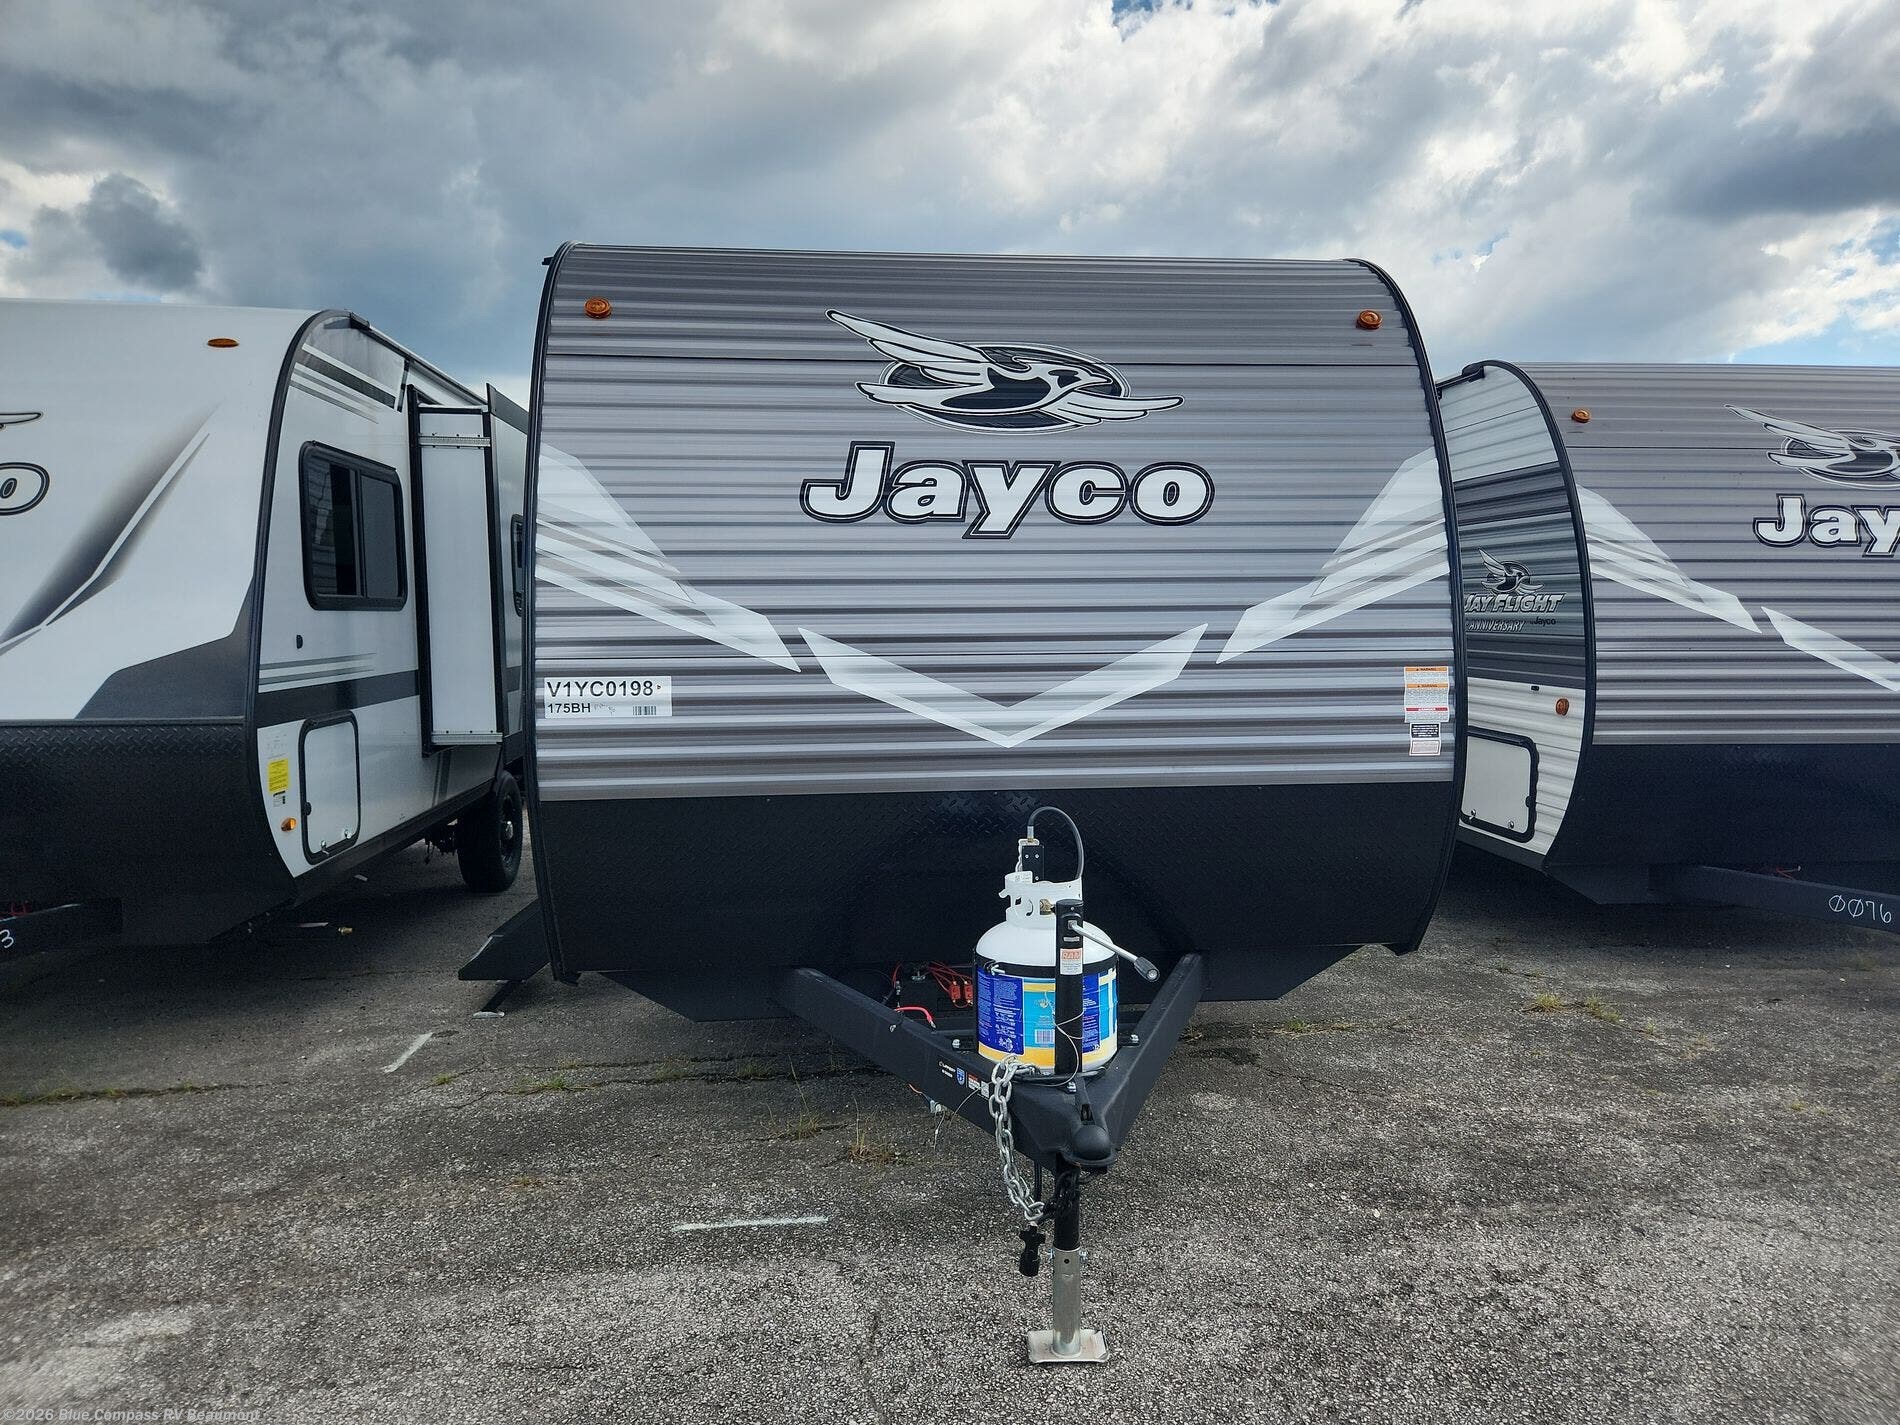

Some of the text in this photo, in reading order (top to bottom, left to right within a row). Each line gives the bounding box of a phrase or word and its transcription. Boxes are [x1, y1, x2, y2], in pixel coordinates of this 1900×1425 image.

[800, 441, 1216, 540] Jayco
[1464, 592, 1566, 612] JAY FLIGHT
[1468, 619, 1526, 632] ANNIVERSARY
[547, 680, 653, 697] V1YC0198
[547, 702, 591, 714] 175BH
[1828, 894, 1892, 923] 0076
